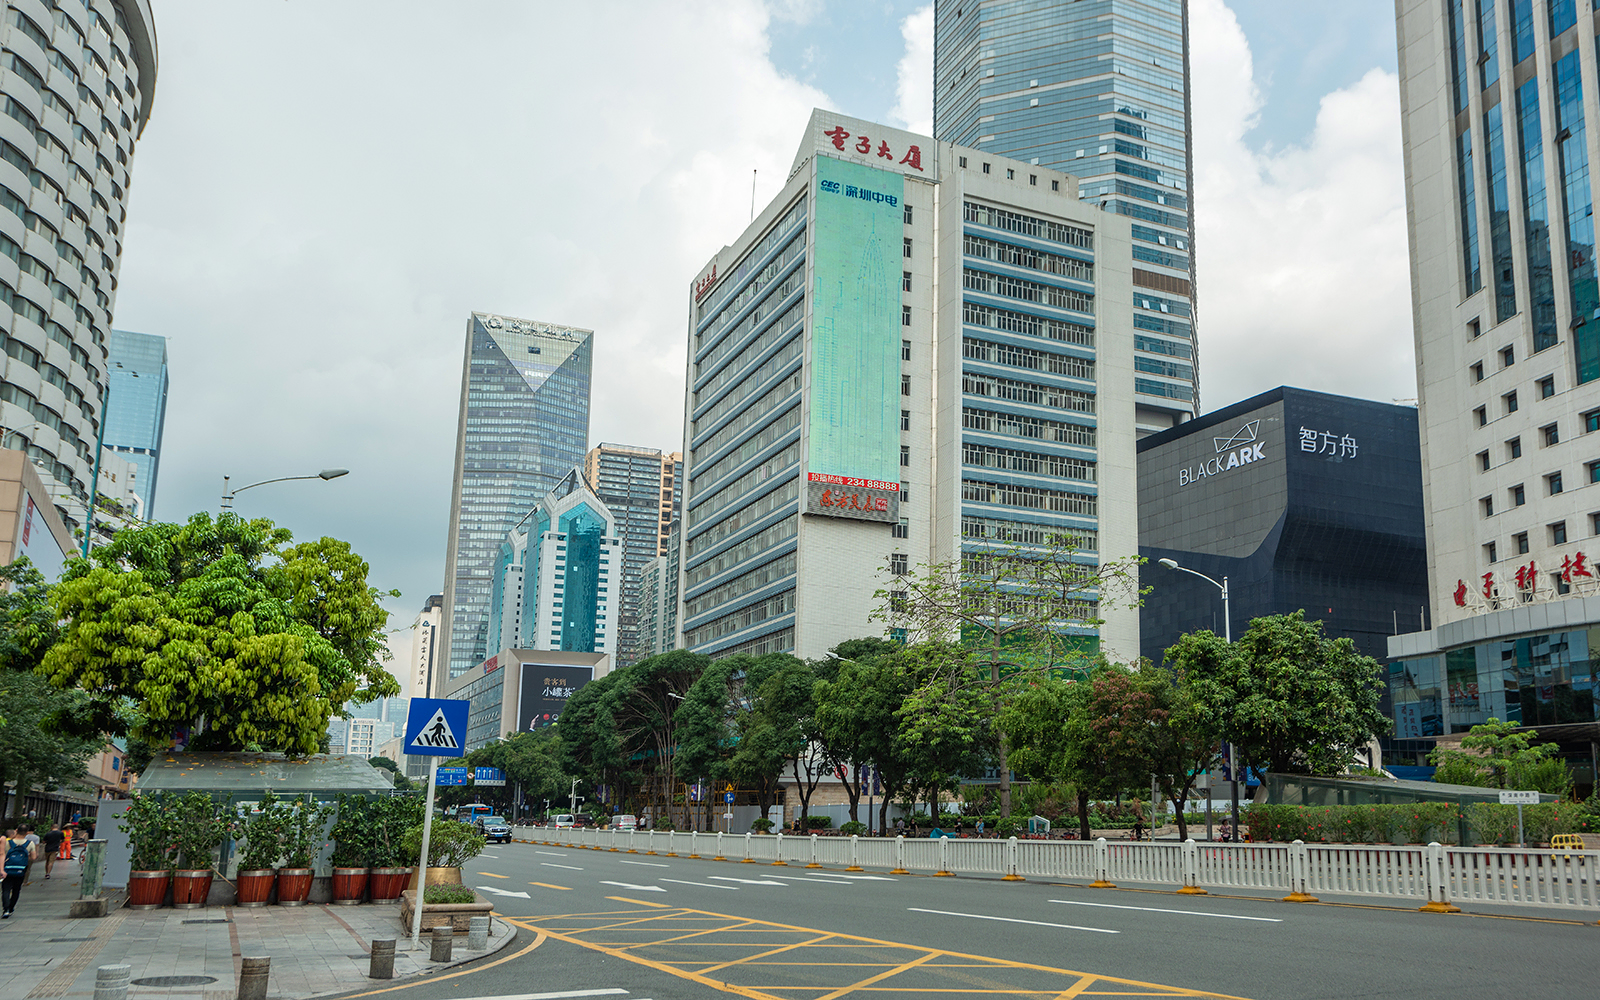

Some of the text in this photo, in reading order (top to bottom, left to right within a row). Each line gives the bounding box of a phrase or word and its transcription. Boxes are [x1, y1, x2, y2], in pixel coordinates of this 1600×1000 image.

[820, 179, 840, 190] CEC
[845, 184, 898, 208] 深圳中电
[1299, 426, 1359, 459] 智方舟
[847, 477, 865, 487] 234
[867, 480, 897, 491] 88888
[1453, 551, 1593, 607] 电子科技
[541, 686, 573, 698] 小罐茶
